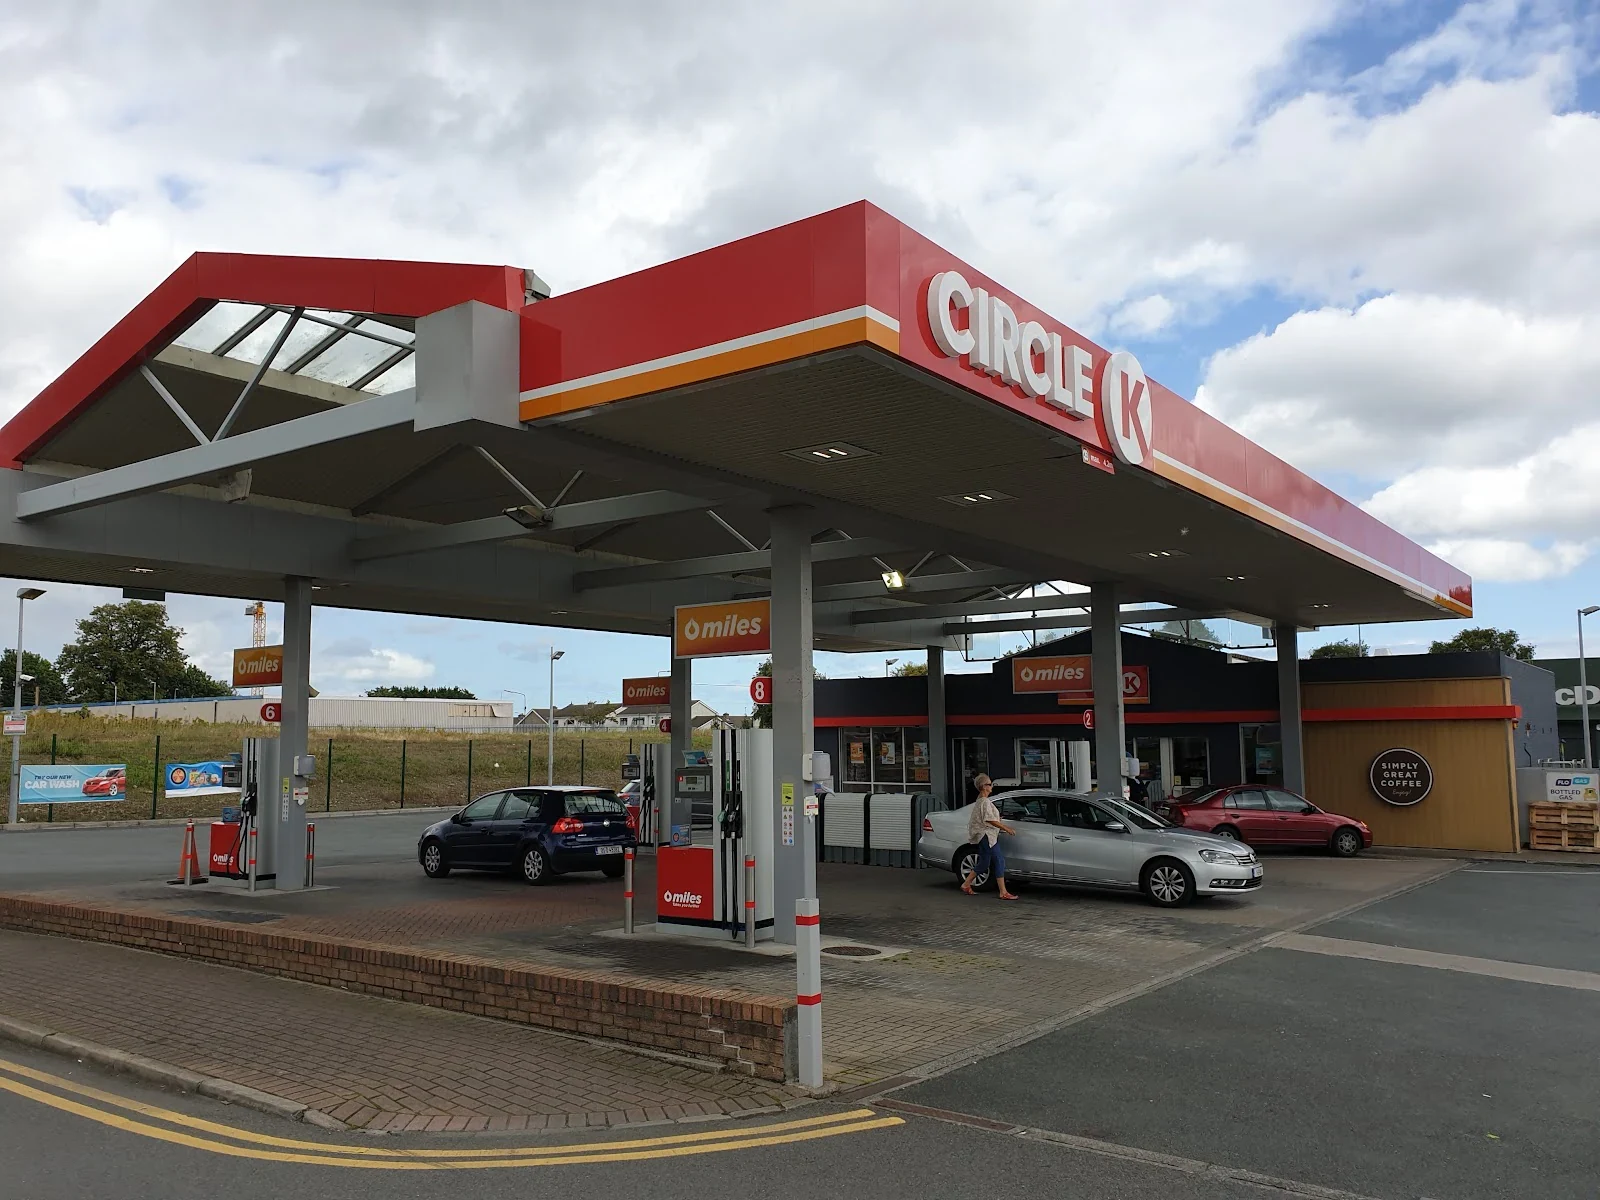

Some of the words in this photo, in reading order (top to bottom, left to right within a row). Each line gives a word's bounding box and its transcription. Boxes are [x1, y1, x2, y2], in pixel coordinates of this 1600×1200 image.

[928, 270, 1094, 421] CIRCLE
[1116, 364, 1151, 465] K
[701, 614, 762, 639] miles
[246, 656, 279, 674] miles
[1035, 665, 1085, 681] miles
[635, 685, 666, 697] miles
[755, 682, 765, 700] 8
[265, 705, 276, 720] 6
[1085, 713, 1092, 726] 2
[661, 722, 668, 732] 4
[1381, 762, 1419, 770] SIMPLY
[24, 780, 47, 790] CAR
[49, 780, 80, 789] WASH
[217, 854, 234, 864] mils
[672, 891, 702, 904] miles
